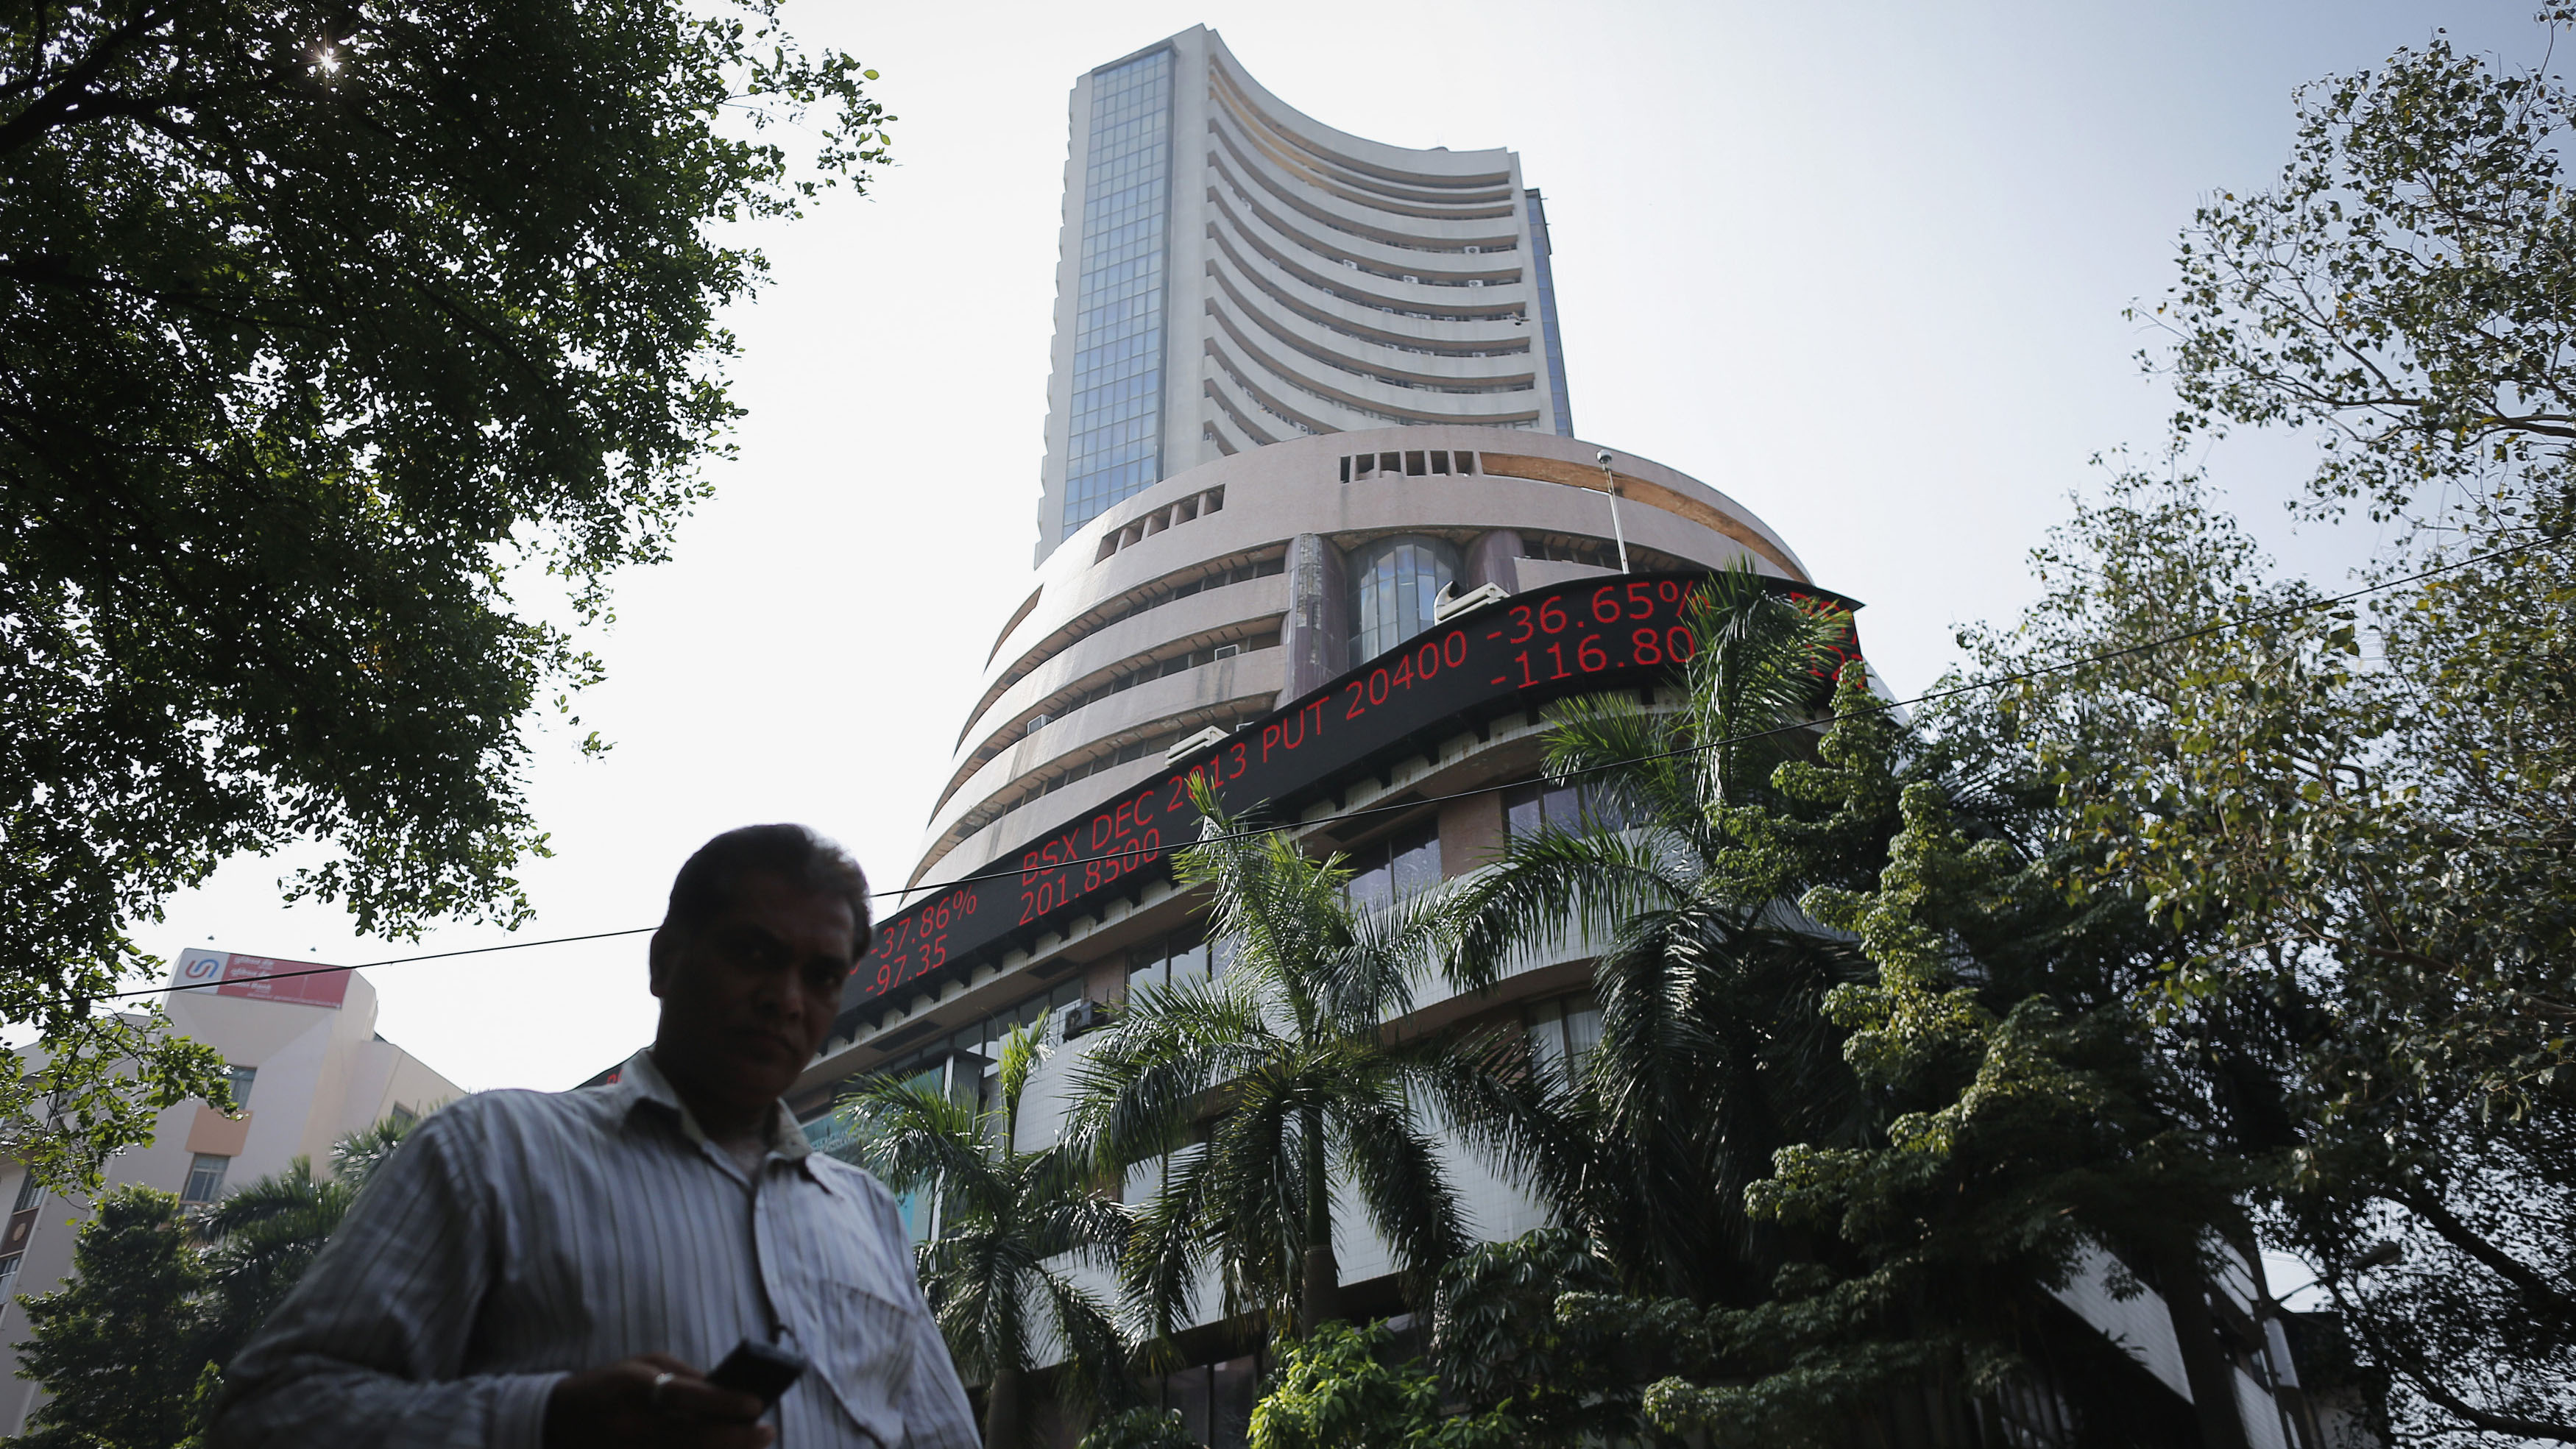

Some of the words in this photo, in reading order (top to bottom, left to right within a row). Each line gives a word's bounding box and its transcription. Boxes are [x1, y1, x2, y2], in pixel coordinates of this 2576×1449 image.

[1486, 580, 1711, 645] -36.65%
[1490, 626, 1696, 690] -116.80
[1022, 829, 1079, 888] BSX
[1091, 790, 1155, 851] DEC
[1167, 743, 1247, 813] 2013
[1262, 695, 1330, 763] PUT
[1345, 630, 1467, 721] 20400
[1019, 828, 1160, 926] 201.8500
[871, 885, 977, 959] -37.86%
[866, 933, 948, 996] -97.35
